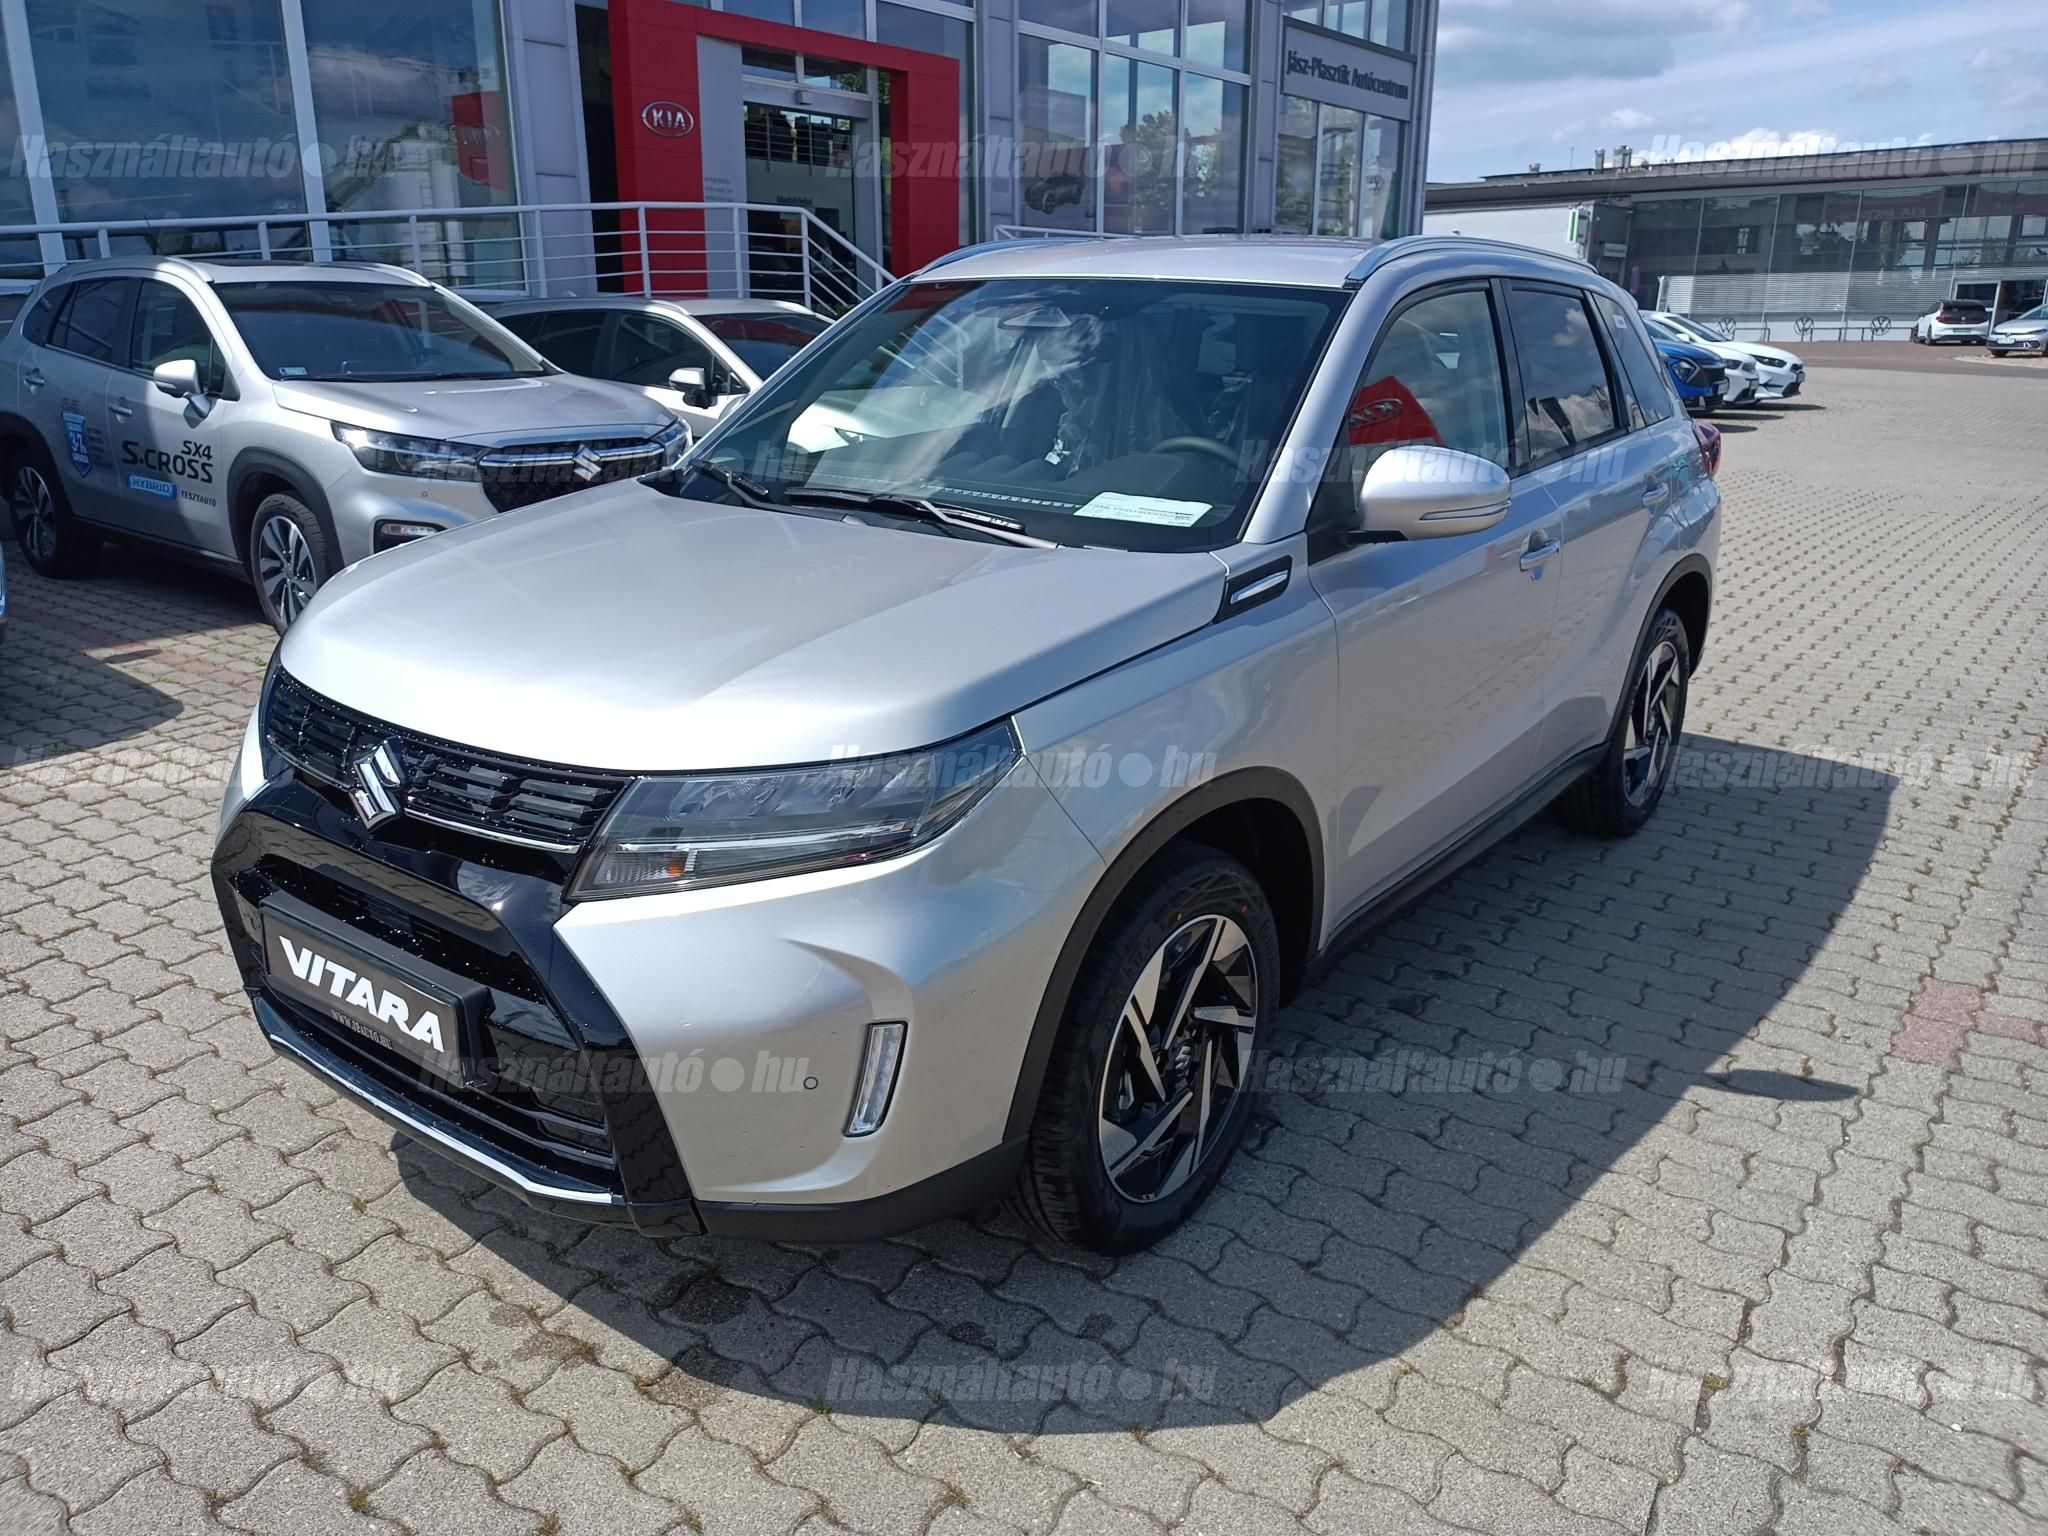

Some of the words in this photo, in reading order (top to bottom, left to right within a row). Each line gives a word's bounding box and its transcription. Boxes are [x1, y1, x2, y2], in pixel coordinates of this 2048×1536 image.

[1286, 50, 1350, 85] Jász-Plasztik
[1351, 68, 1408, 99] Autócentrum
[652, 108, 687, 130] KIA
[181, 440, 213, 461] SX4
[131, 475, 171, 494] HYBRID
[279, 935, 445, 1054] VITARA
